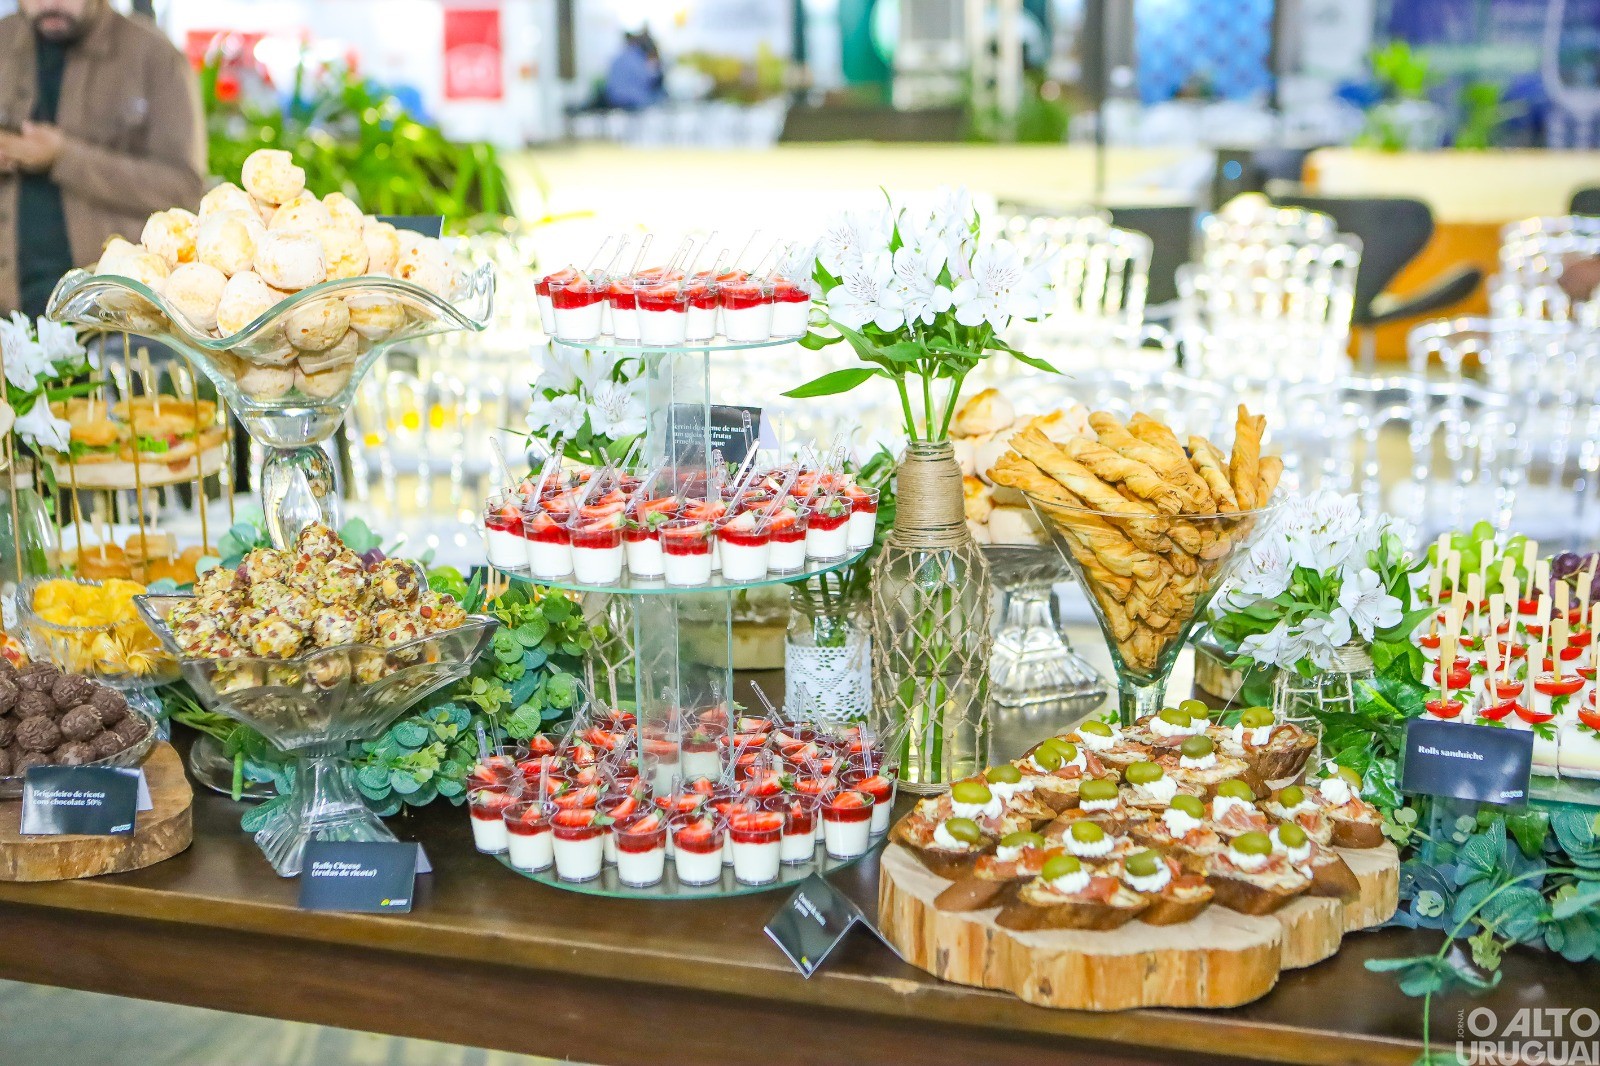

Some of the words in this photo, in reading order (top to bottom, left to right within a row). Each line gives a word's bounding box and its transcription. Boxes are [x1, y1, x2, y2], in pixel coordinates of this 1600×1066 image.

[712, 432, 732, 440] frutas
[1418, 745, 1440, 756] Rolls
[33, 789, 72, 798] Brigadeiro
[73, 789, 82, 798] de
[83, 790, 105, 798] ricota
[49, 798, 85, 806] chocolate
